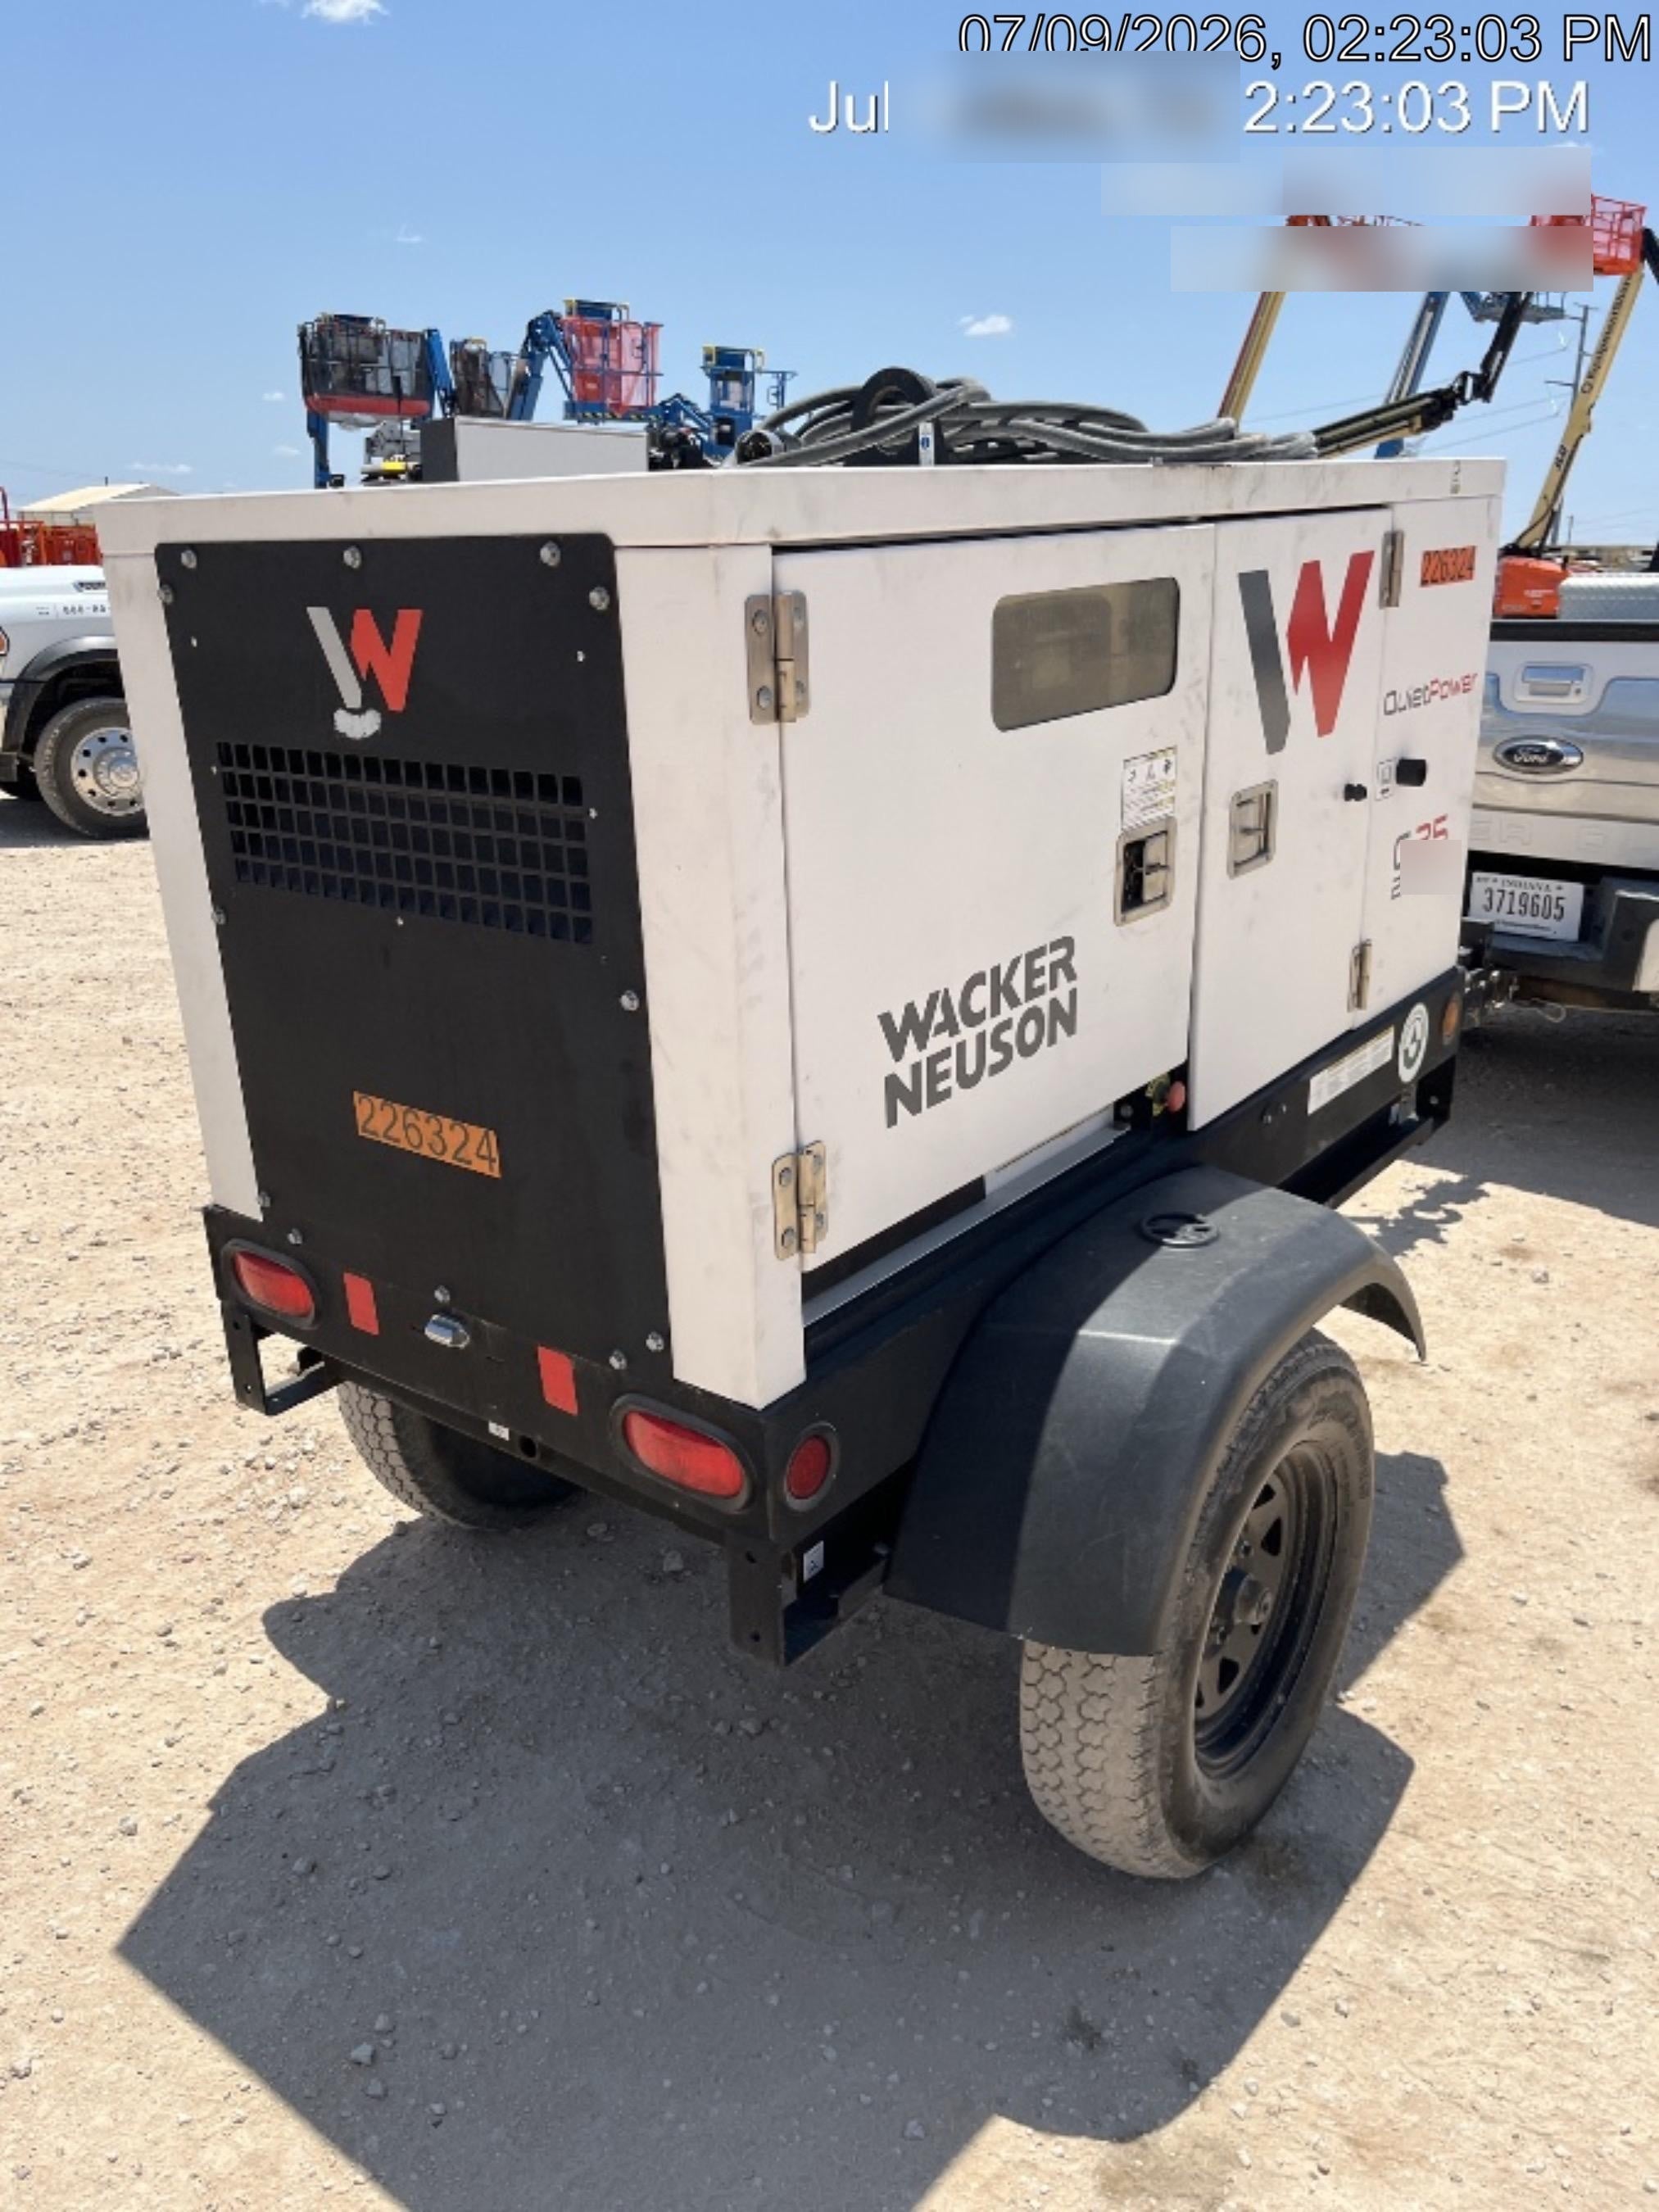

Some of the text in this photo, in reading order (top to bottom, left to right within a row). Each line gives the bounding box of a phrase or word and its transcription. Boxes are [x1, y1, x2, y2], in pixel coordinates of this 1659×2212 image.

[1482, 886, 1566, 922] 3719605
[878, 936, 1078, 1063] WACKER
[884, 988, 1078, 1129] NEUSON
[358, 1095, 496, 1173] 226324
